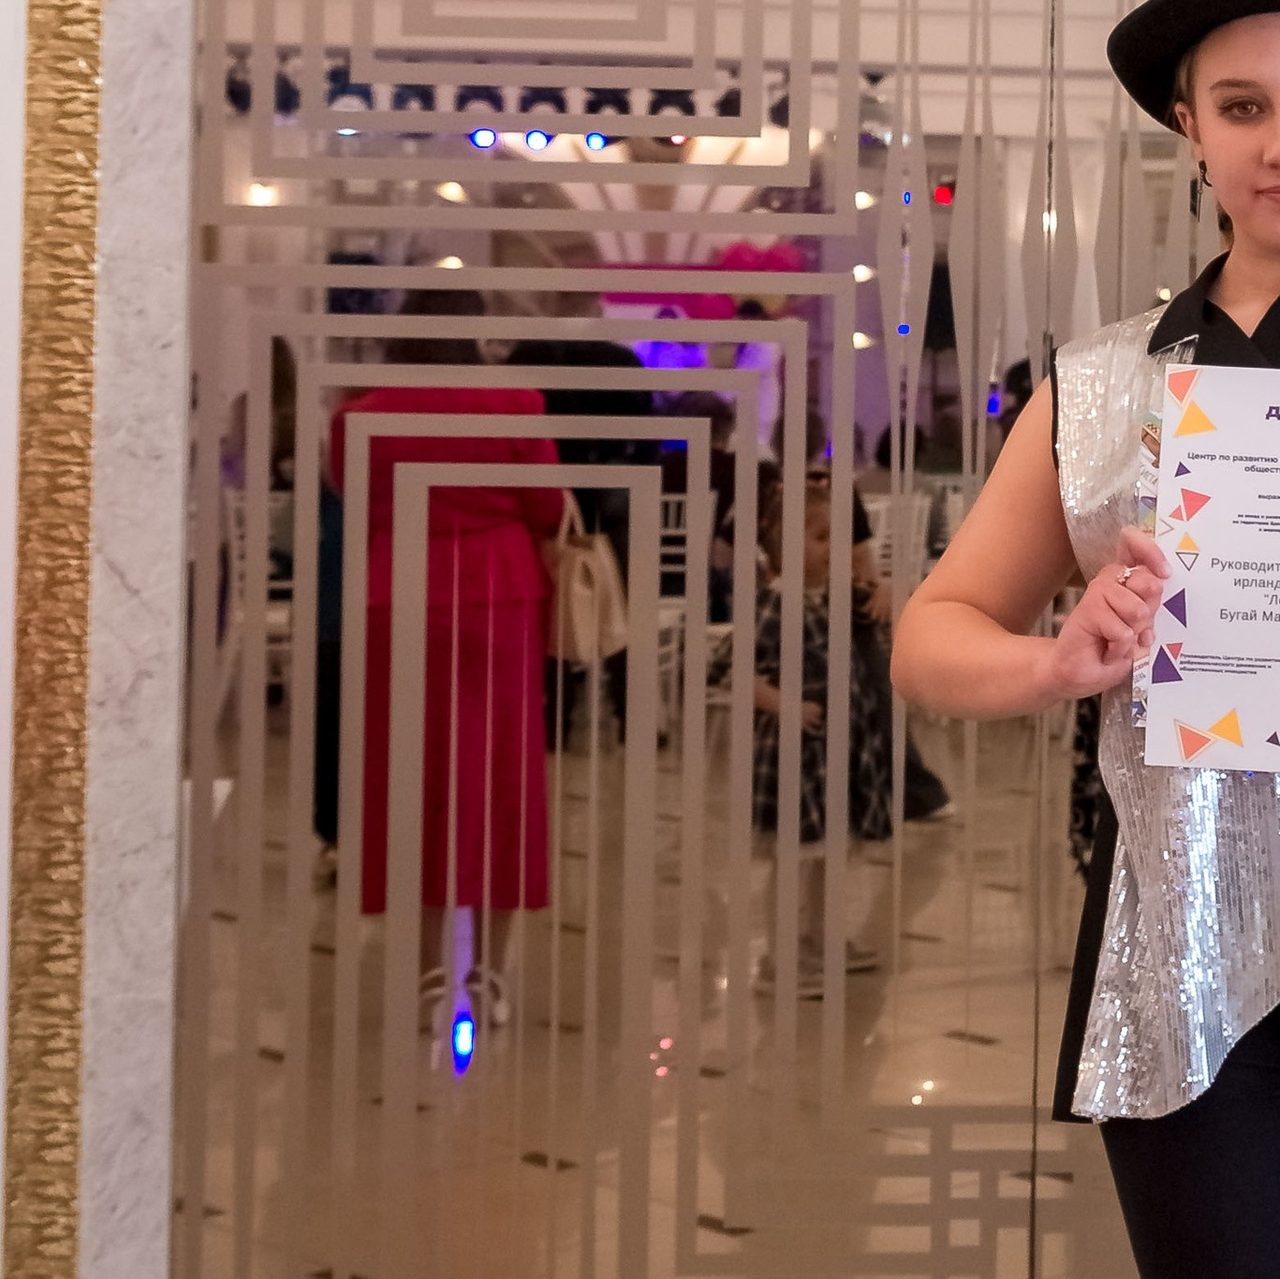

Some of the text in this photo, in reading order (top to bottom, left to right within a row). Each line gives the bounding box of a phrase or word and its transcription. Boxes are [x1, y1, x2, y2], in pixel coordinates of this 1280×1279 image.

[1187, 451, 1218, 462] Центр
[1232, 455, 1279, 465] развитию
[1219, 608, 1258, 623] Бугай
